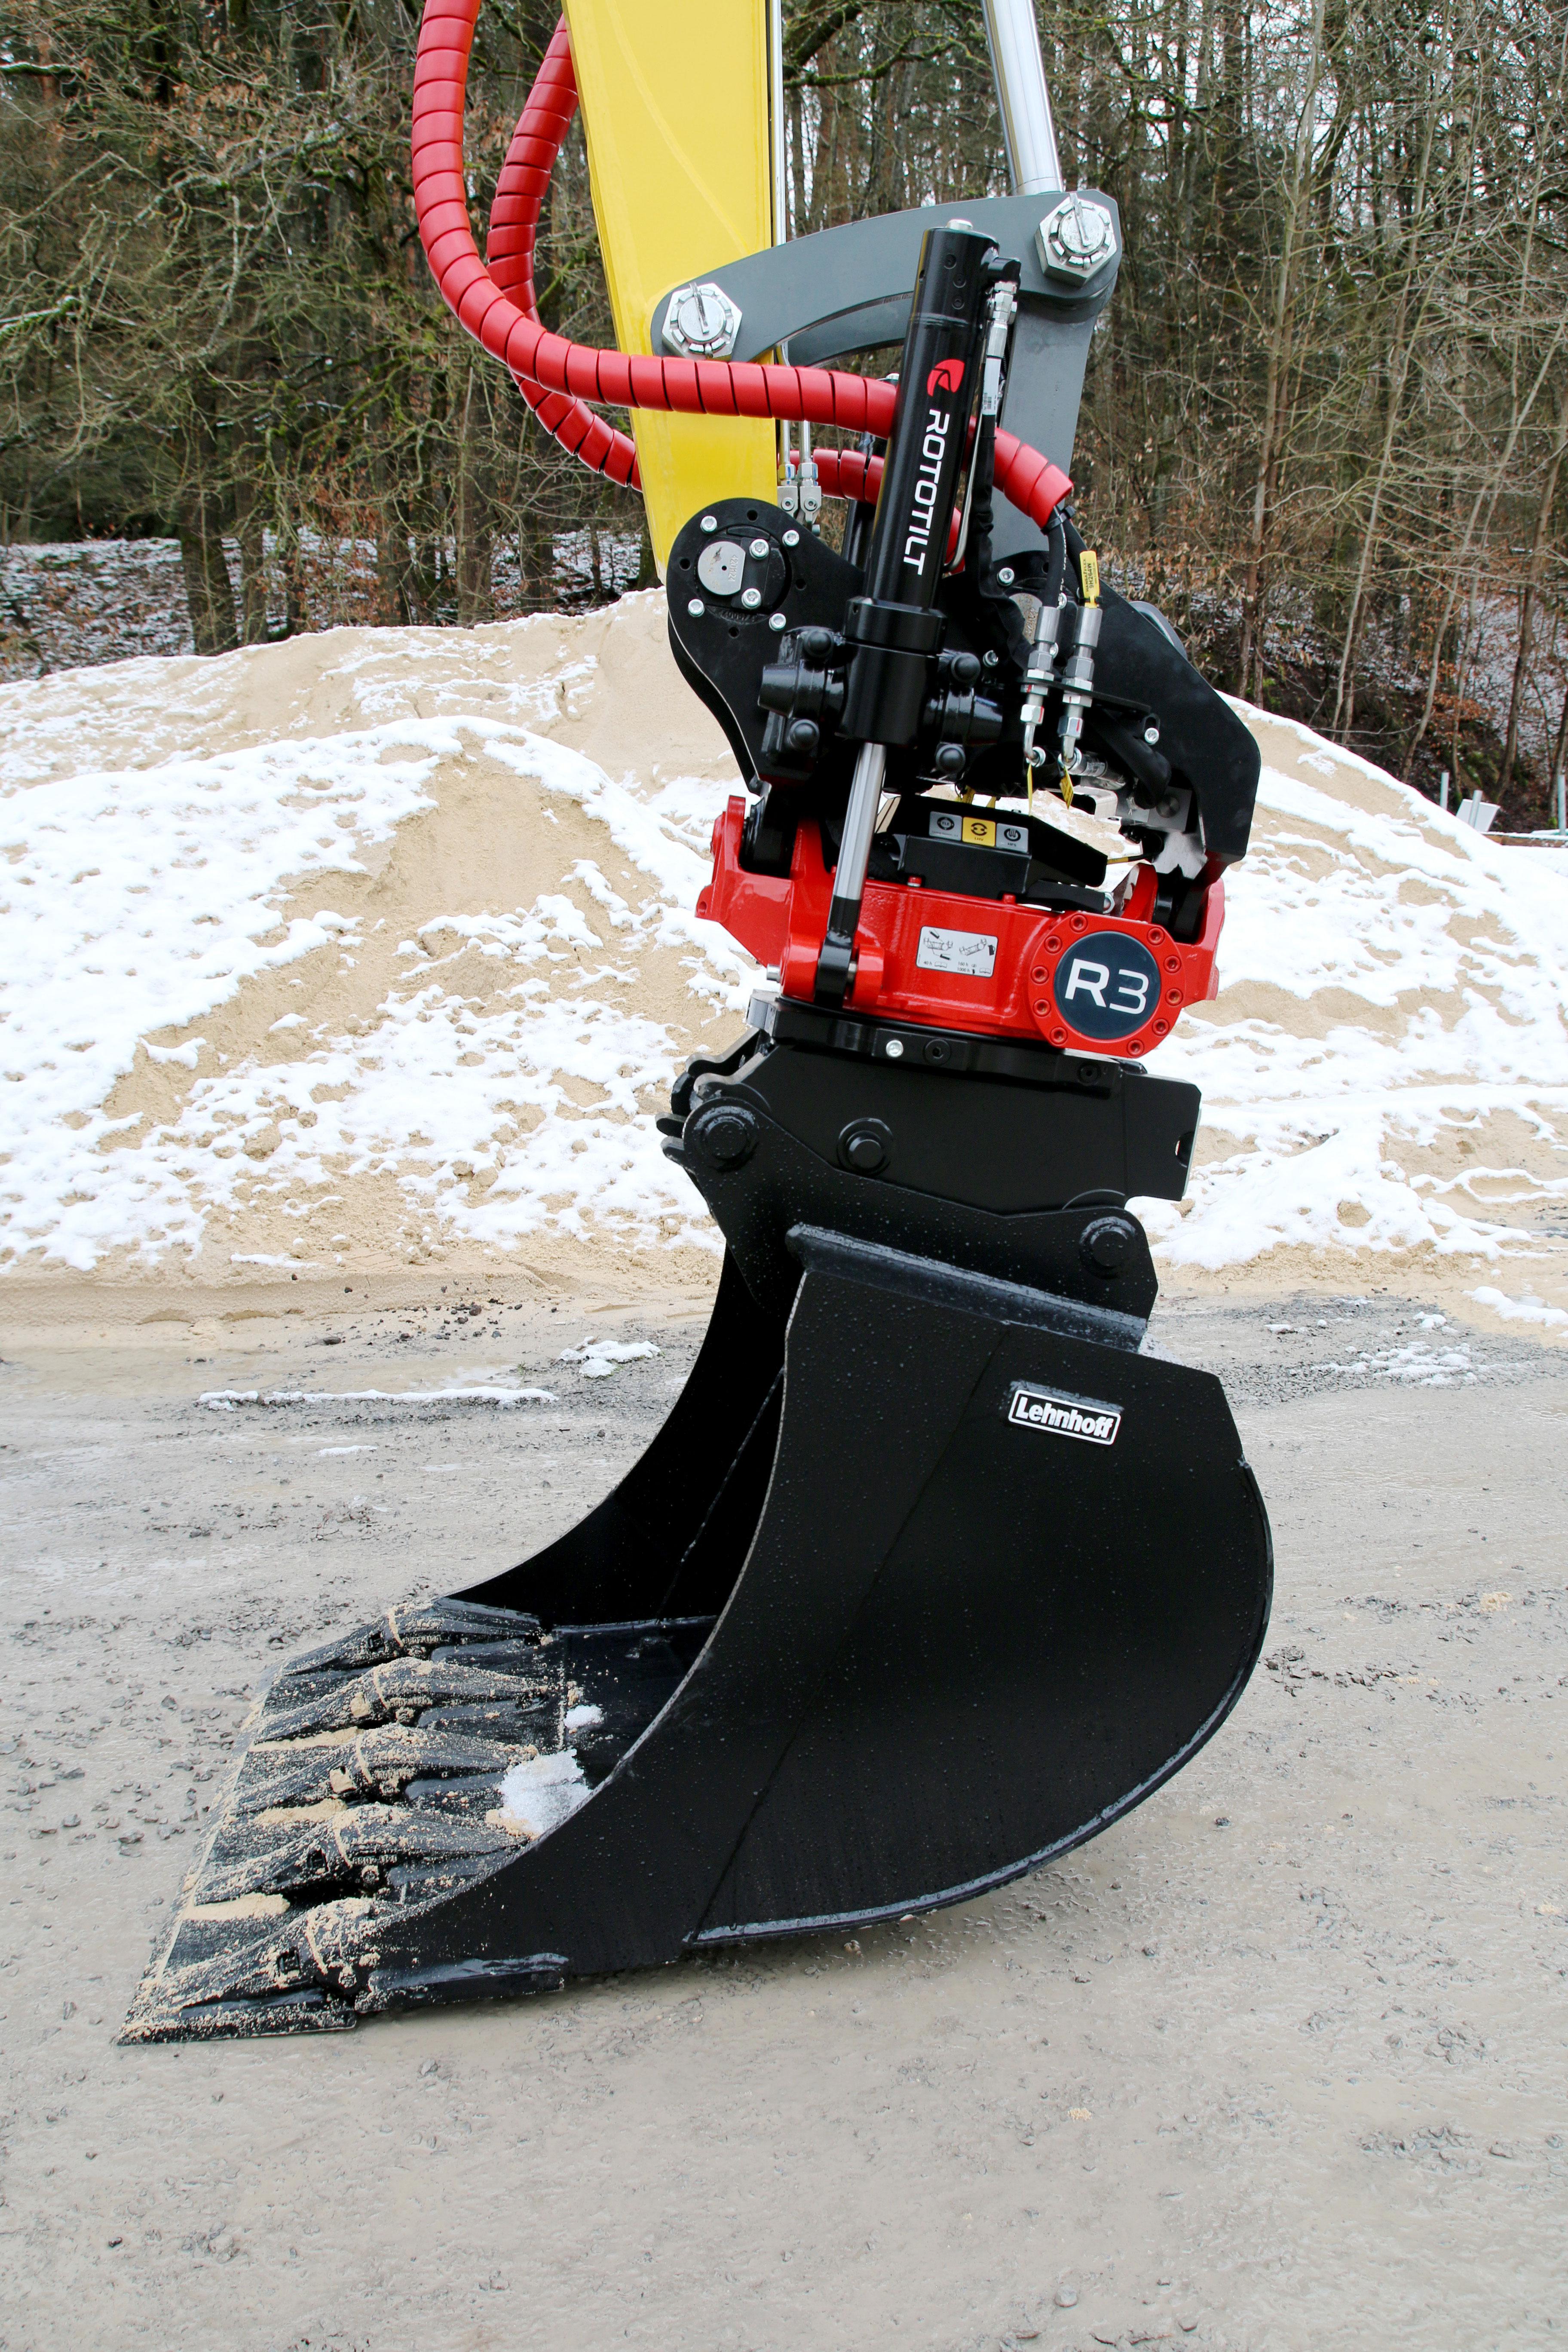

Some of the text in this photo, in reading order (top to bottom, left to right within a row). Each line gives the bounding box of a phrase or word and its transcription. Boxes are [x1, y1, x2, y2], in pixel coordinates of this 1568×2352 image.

[903, 408, 950, 576] ROTOTILT
[1065, 958, 1149, 1014] R3
[1016, 1396, 1114, 1439] Lehnhoff
